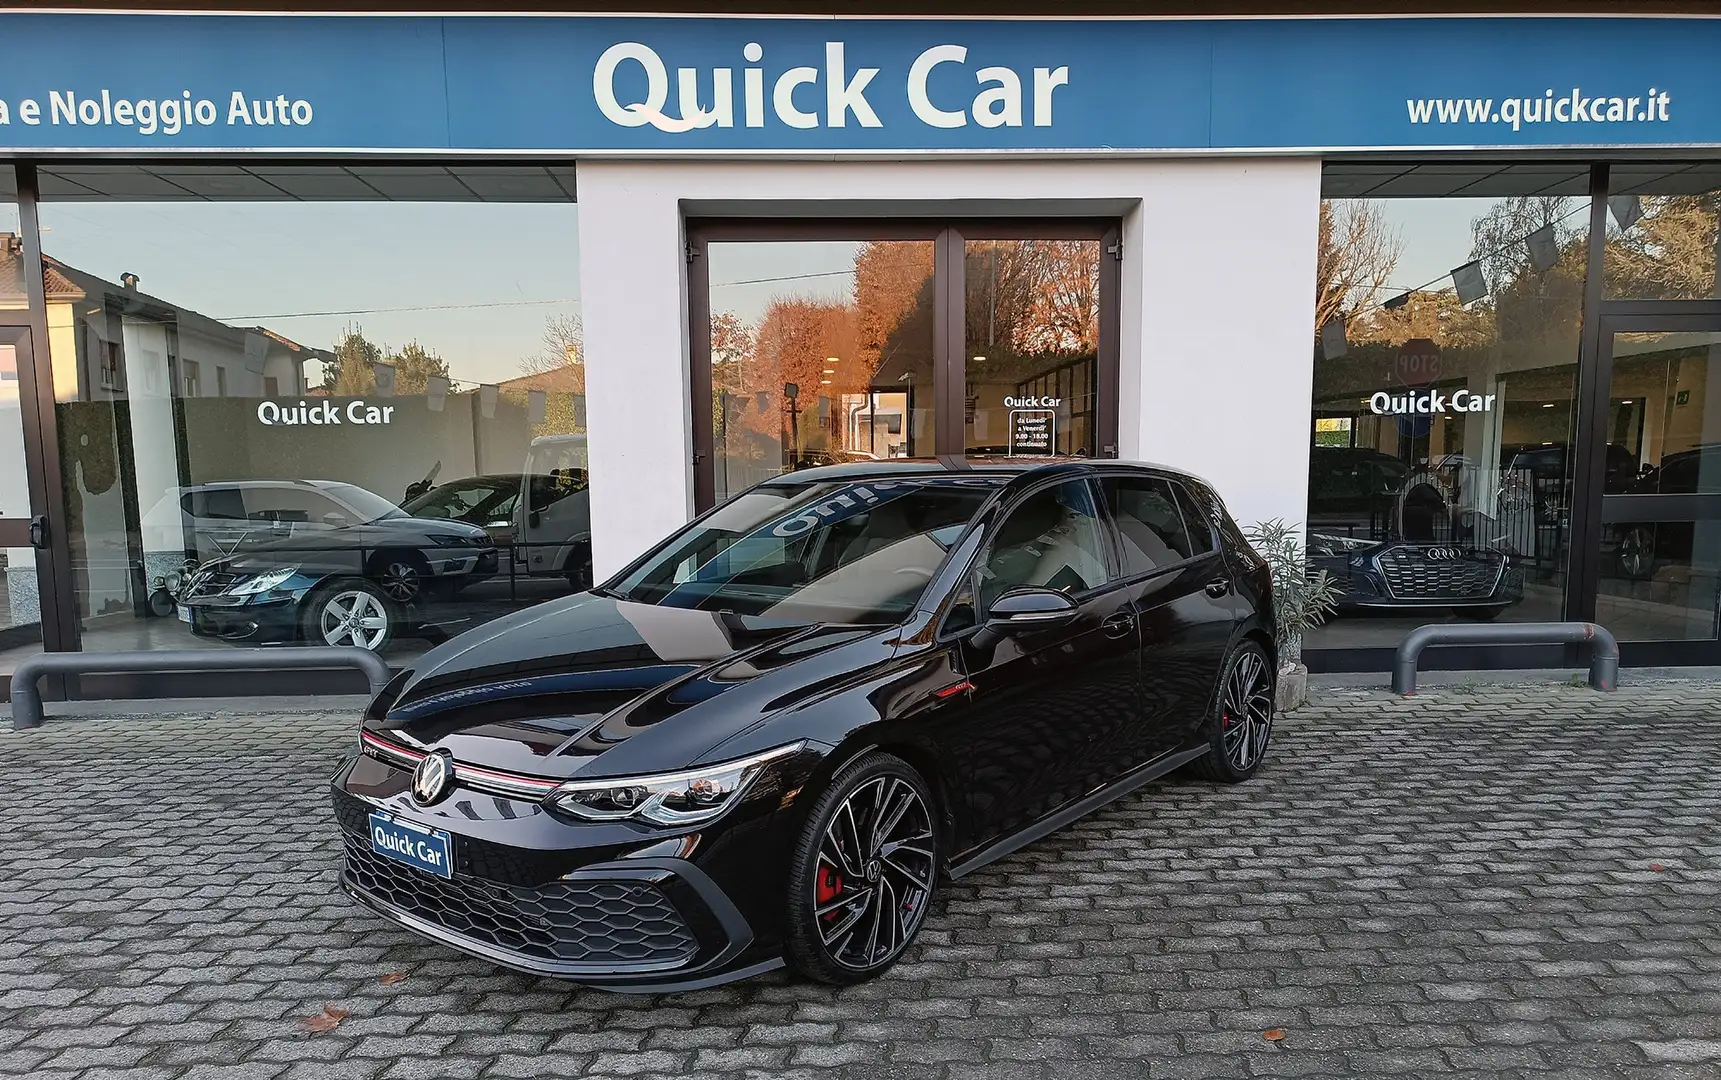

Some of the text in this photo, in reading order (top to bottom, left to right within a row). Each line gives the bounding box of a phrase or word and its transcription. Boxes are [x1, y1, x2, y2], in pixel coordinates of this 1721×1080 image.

[592, 41, 1069, 133] Quick Car
[19, 98, 41, 125] e
[49, 88, 217, 135] Noleggio
[226, 91, 314, 126] Auto
[1406, 88, 1671, 131] www.quickcar.it
[257, 400, 394, 426] Quick Car
[1004, 396, 1061, 407] Quick Car
[1370, 389, 1496, 416] Quick Car
[374, 826, 441, 866] Quick Car
